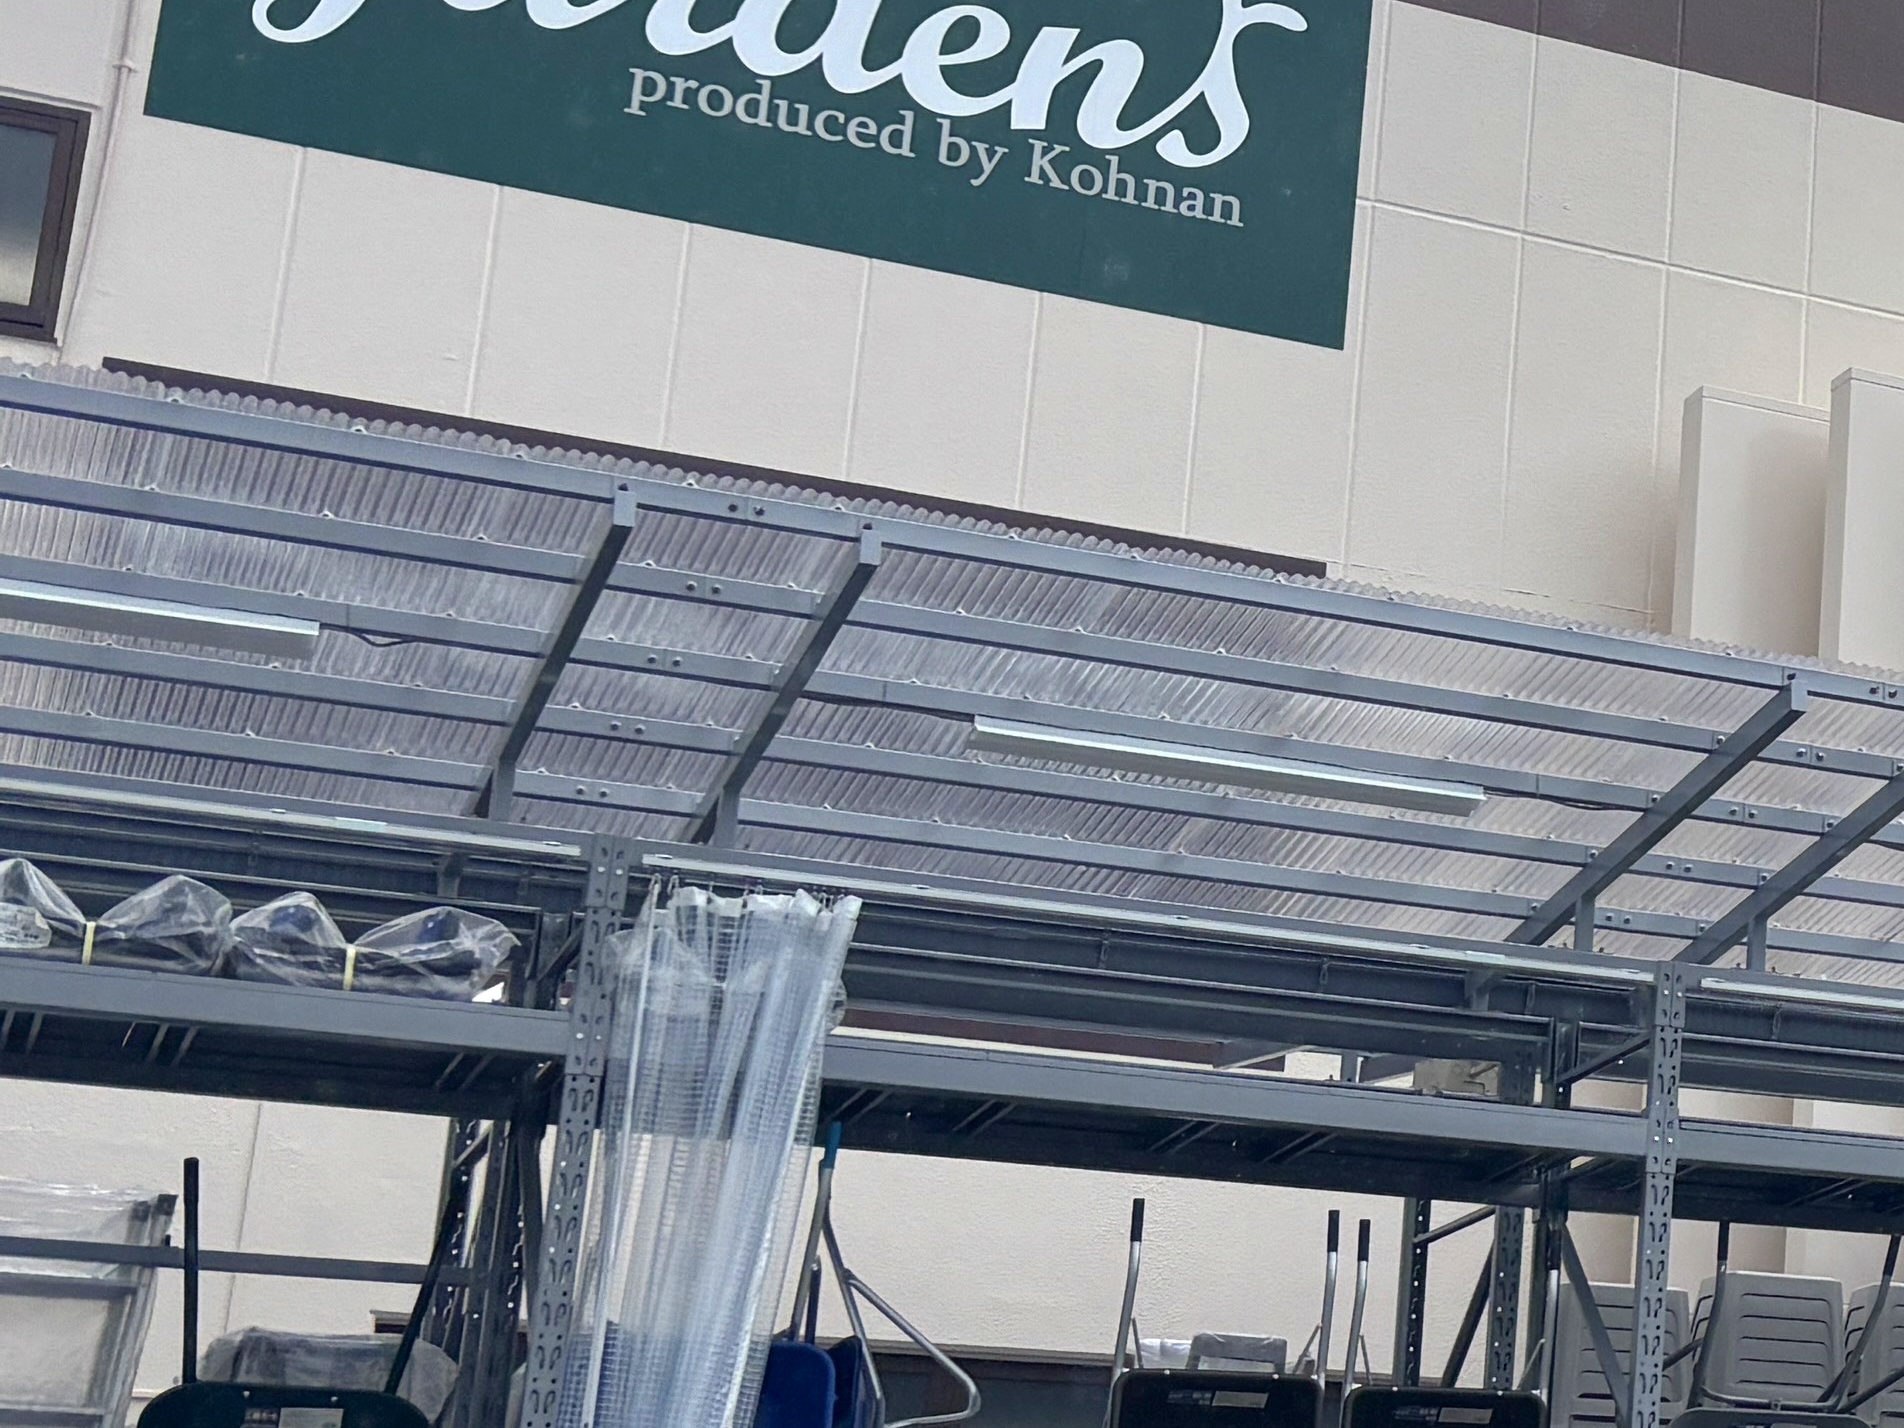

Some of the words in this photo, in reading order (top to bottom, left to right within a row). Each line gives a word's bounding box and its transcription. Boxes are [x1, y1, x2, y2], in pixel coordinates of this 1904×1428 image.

[624, 68, 915, 159] produced
[938, 119, 1009, 188] by
[1023, 138, 1245, 229] Kohnan
